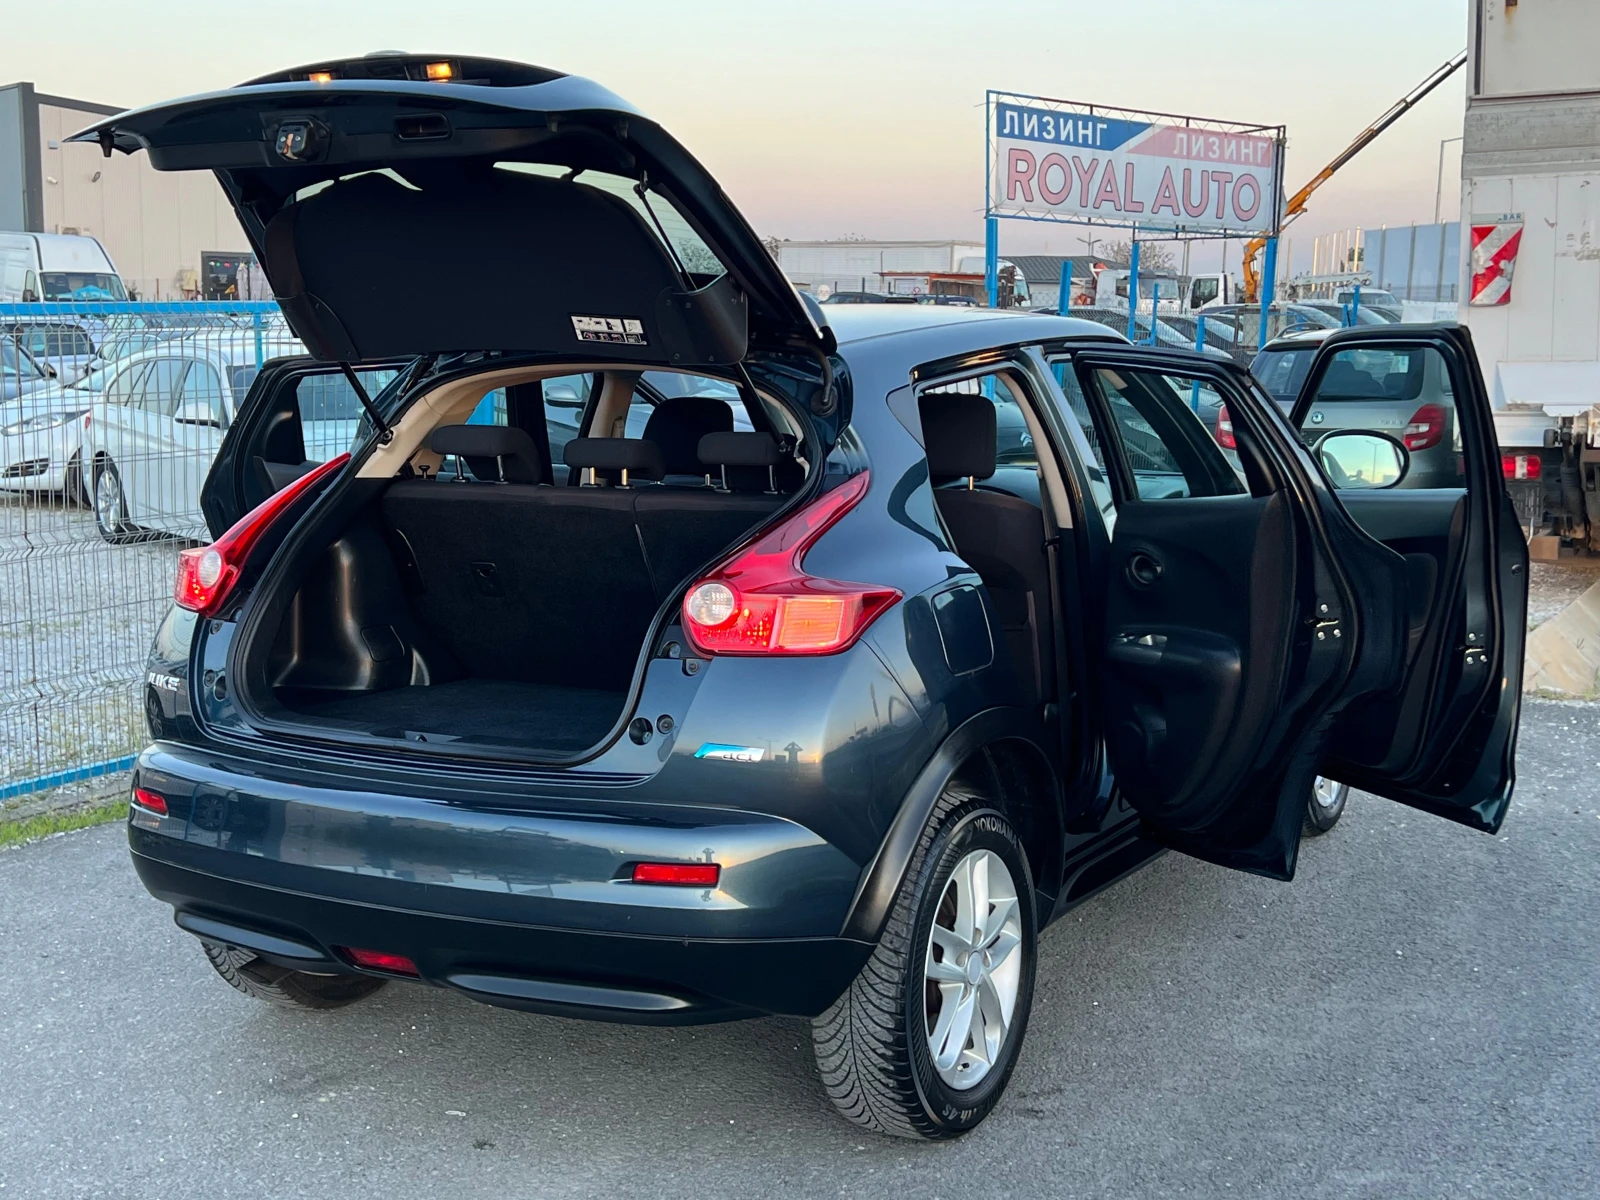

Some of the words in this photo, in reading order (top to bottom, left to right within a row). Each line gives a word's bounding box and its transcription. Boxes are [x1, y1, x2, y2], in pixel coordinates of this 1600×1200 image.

[1003, 110, 1107, 146] ЛИЗИНГ
[1173, 133, 1267, 164] ЛИЗИНГ
[1007, 148, 1144, 213] ROYAL
[1151, 165, 1261, 222] AUTO
[974, 816, 1017, 848] YOKOHAMA
